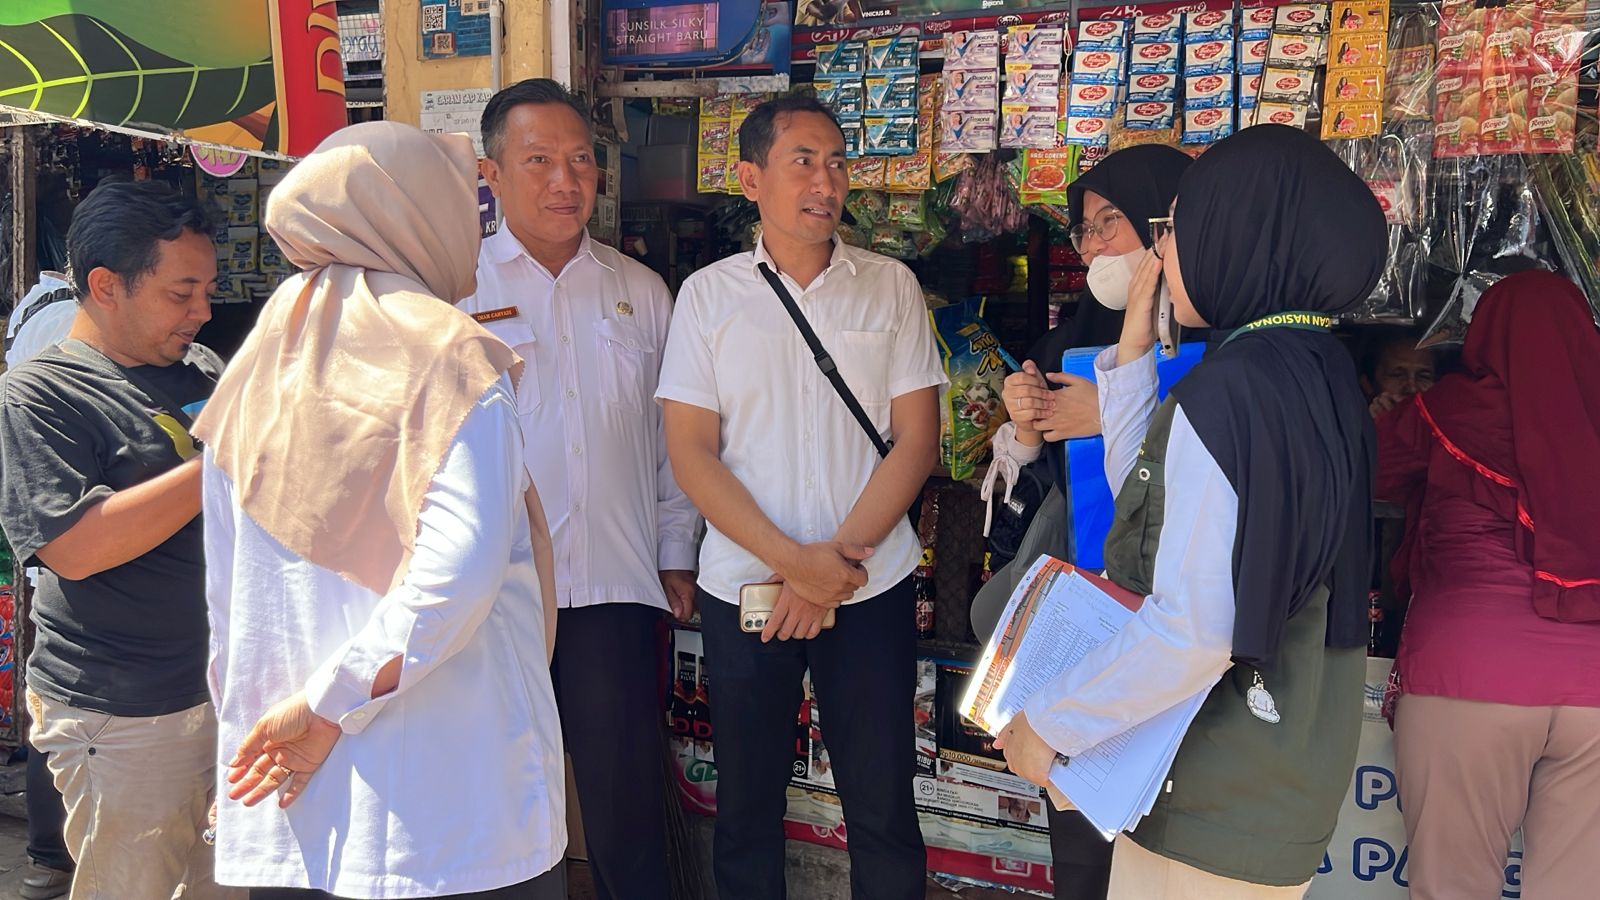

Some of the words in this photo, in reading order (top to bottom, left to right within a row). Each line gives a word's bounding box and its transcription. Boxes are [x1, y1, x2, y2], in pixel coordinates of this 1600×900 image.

[862, 10, 885, 18] VINICIUS
[620, 19, 667, 32] SUNSILK
[672, 17, 705, 29] SILKY
[616, 32, 673, 46] STRAIGHT
[676, 30, 708, 42] BARU
[1536, 31, 1561, 41] Royco
[1441, 37, 1462, 48] Royco
[1437, 123, 1458, 133] Royco
[1484, 119, 1506, 130] Royco
[1532, 117, 1553, 128] Royco
[1246, 314, 1310, 330] NASIONAL
[1312, 316, 1330, 328] GAN
